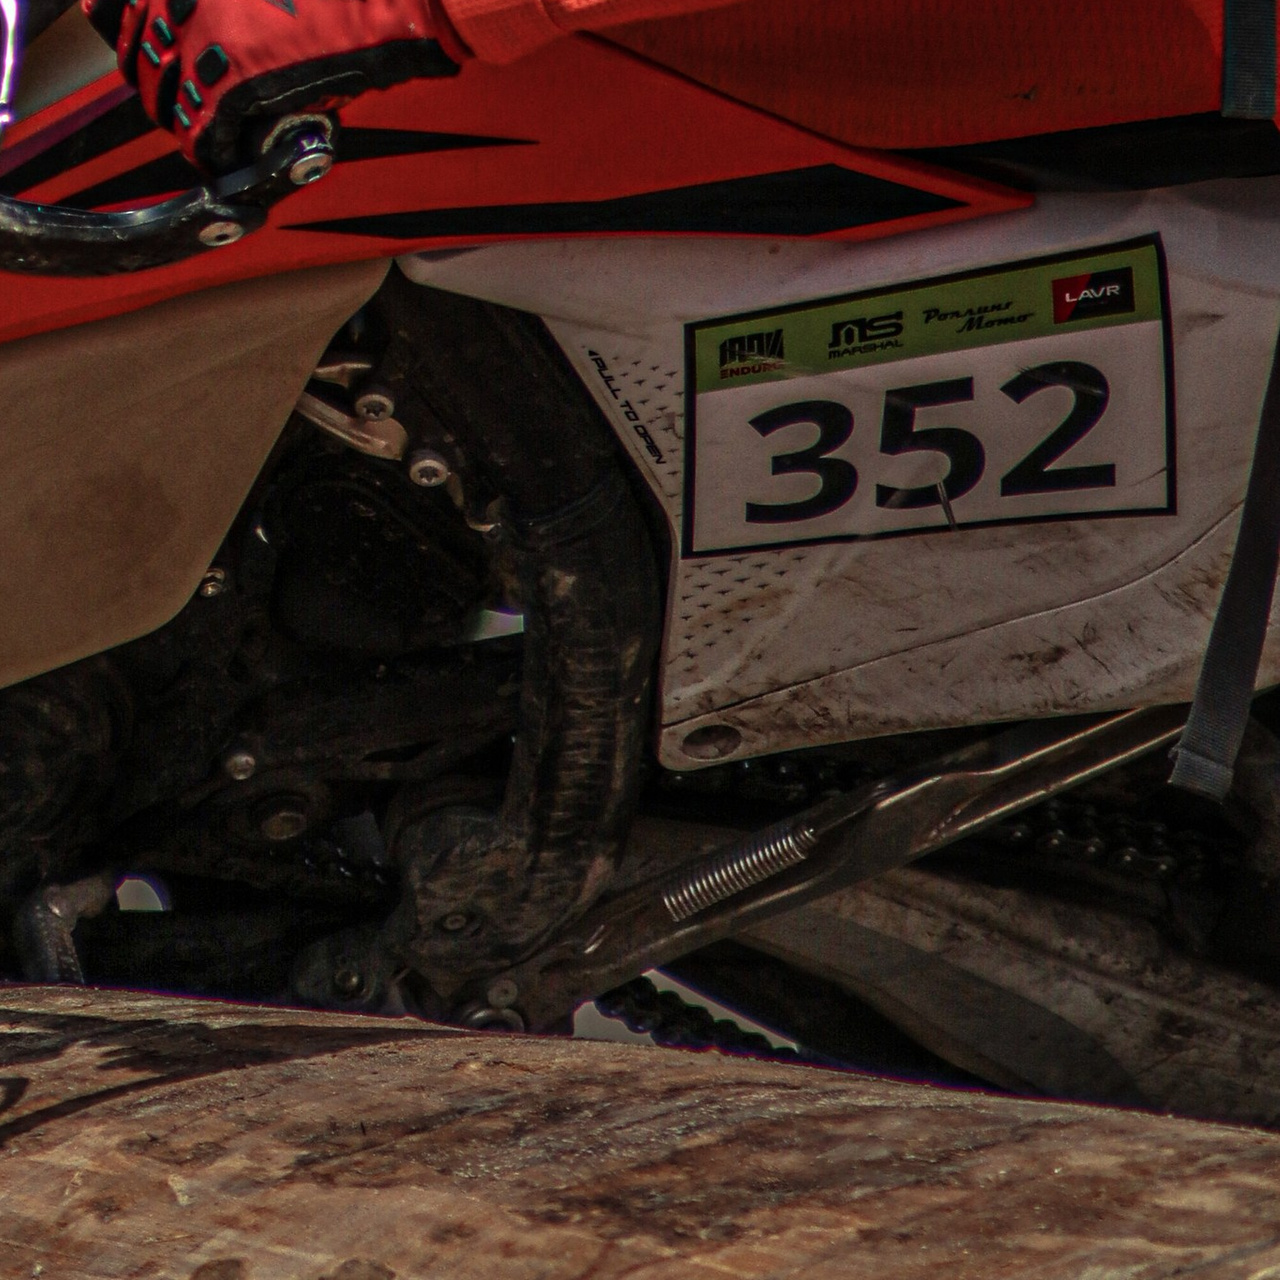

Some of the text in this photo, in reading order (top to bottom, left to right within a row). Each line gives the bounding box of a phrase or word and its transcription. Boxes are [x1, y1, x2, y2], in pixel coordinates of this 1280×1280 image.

[1065, 285, 1121, 303] LAVR
[828, 340, 904, 360] MARSHAL
[591, 357, 667, 464] PULL TO OPEN
[745, 360, 1116, 523] 352
